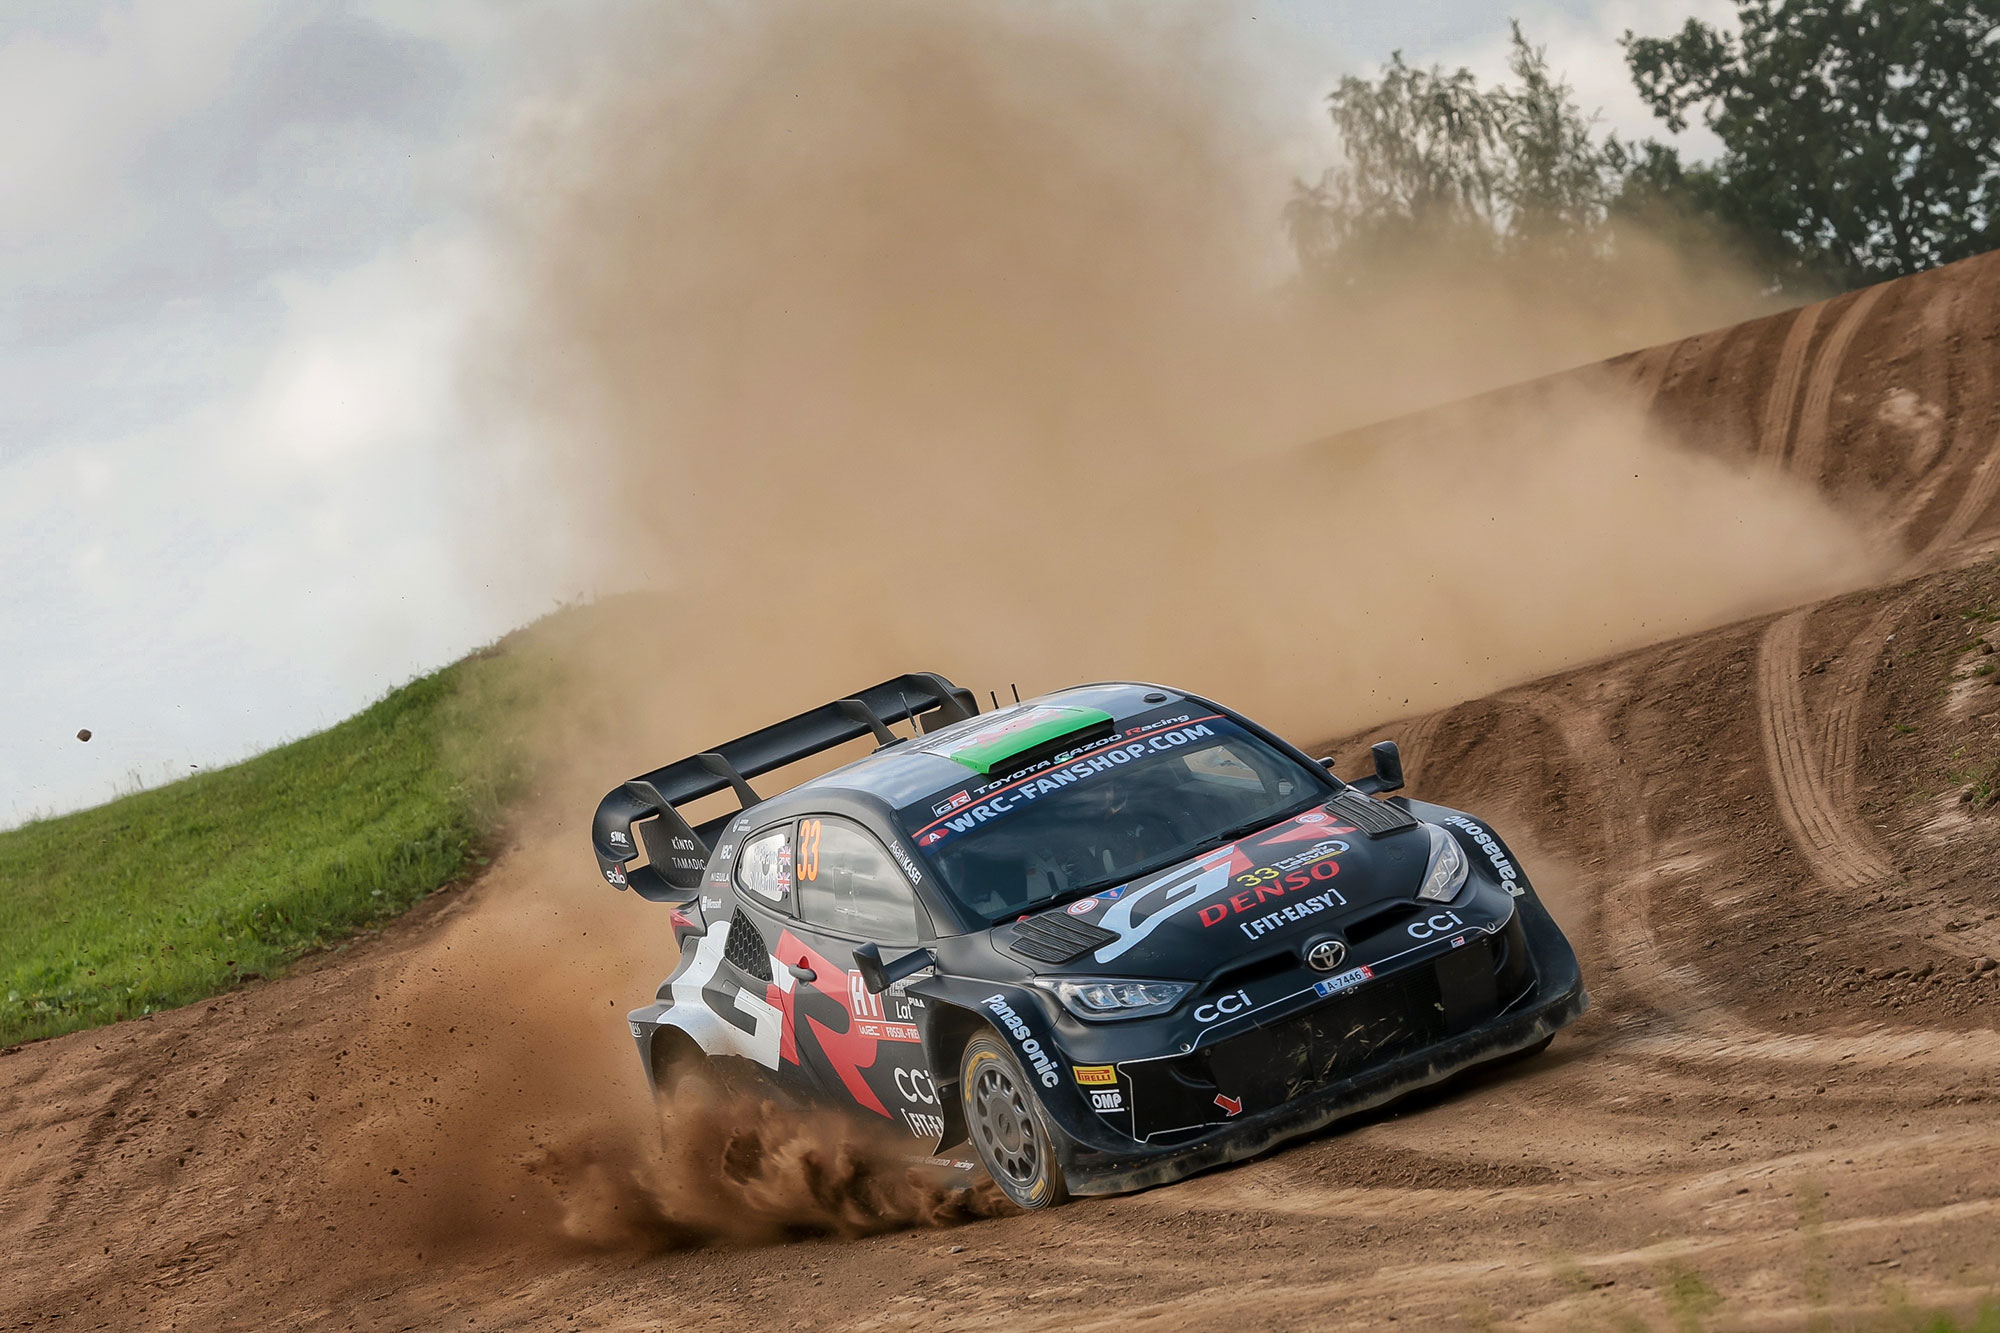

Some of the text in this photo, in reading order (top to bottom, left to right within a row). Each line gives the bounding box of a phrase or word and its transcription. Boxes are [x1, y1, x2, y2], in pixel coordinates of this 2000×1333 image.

[935, 714, 1190, 816] GR TOYOTA GAZOO Racing
[944, 724, 1215, 833] WRC-FANSHOP.COM
[672, 857, 706, 870] TAMADIC
[797, 820, 821, 882] 33
[1237, 867, 1280, 887] 33
[1444, 816, 1525, 897] Panasonic
[1197, 860, 1340, 928] DENSO
[1240, 888, 1347, 940] [FIT-EASY]
[1327, 971, 1362, 991] A-7446
[895, 1001, 914, 1020] Lat
[981, 993, 1059, 1088] Panasonic
[1076, 1069, 1112, 1083] PIRELLI
[1092, 1093, 1122, 1109] OMP
